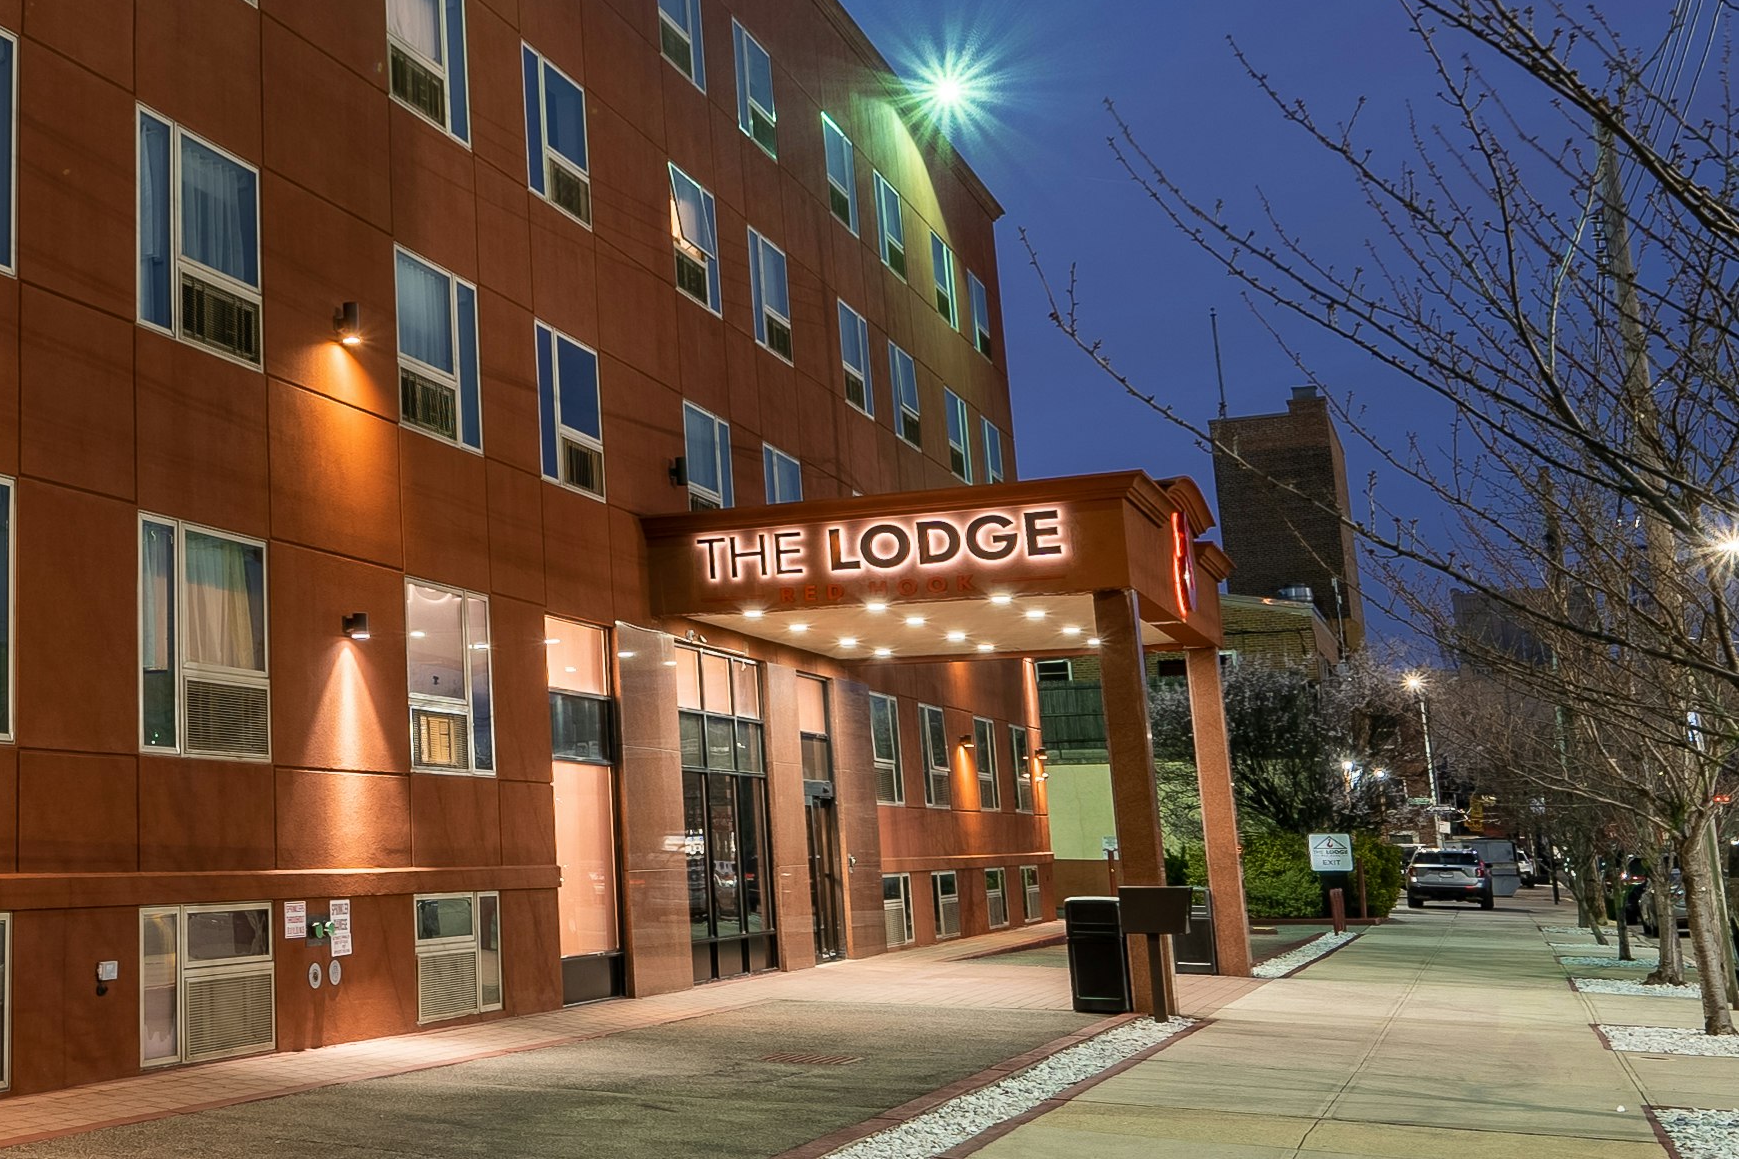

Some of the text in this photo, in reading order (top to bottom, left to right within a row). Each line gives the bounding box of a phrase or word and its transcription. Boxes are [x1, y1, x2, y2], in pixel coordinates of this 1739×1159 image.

[696, 510, 1062, 579] THE LODGE
[779, 573, 975, 603] RED HOOK
